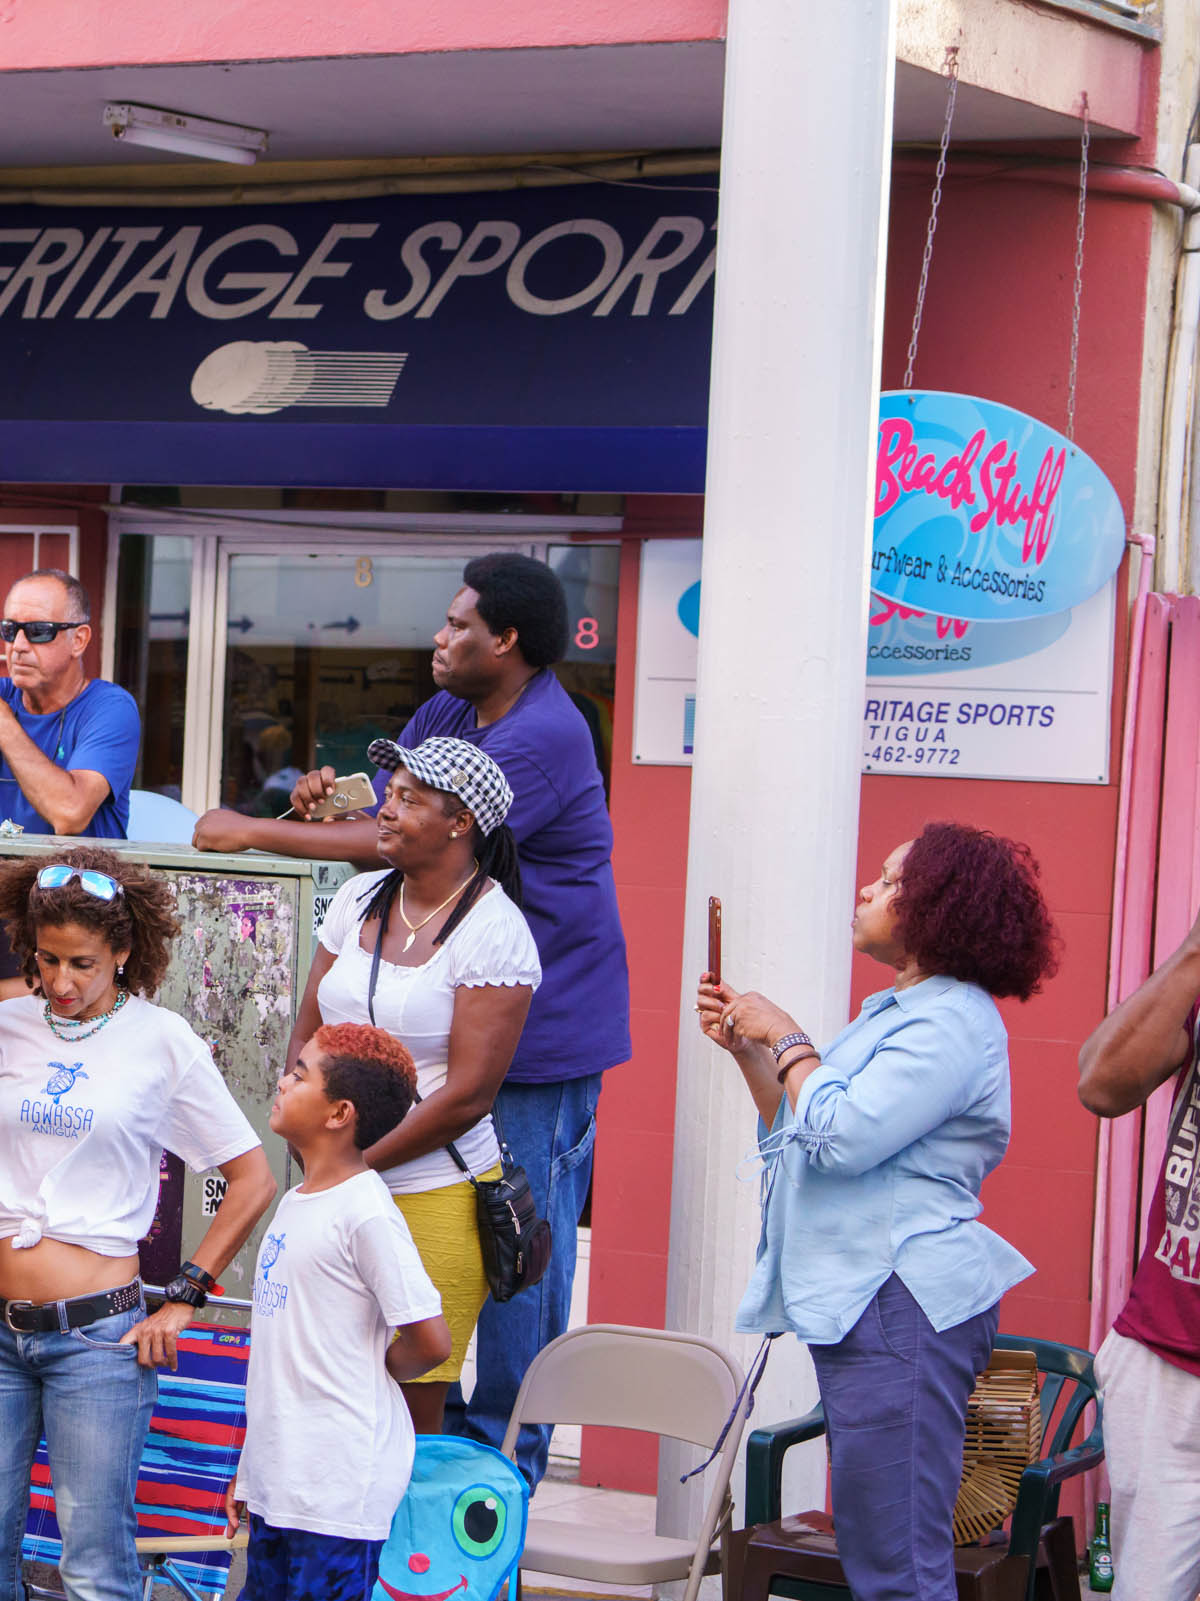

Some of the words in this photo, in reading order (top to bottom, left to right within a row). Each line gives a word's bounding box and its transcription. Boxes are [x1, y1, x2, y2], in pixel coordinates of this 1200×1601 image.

[363, 215, 718, 320] SPORT
[873, 417, 986, 519] Beach
[969, 439, 1066, 566] Stuff
[354, 556, 373, 588] 8
[871, 546, 933, 580] urfwear
[936, 554, 948, 583] &
[951, 561, 1046, 602] Accessories
[574, 617, 600, 649] 8
[868, 644, 972, 661] ccessories
[863, 700, 951, 724] RITAGE
[956, 702, 1056, 727] SPORTS
[869, 725, 947, 743] TIGUA
[863, 746, 961, 765] -462-9772
[20, 1099, 94, 1132] AGWASSA
[32, 1123, 79, 1139] ANTIGUA
